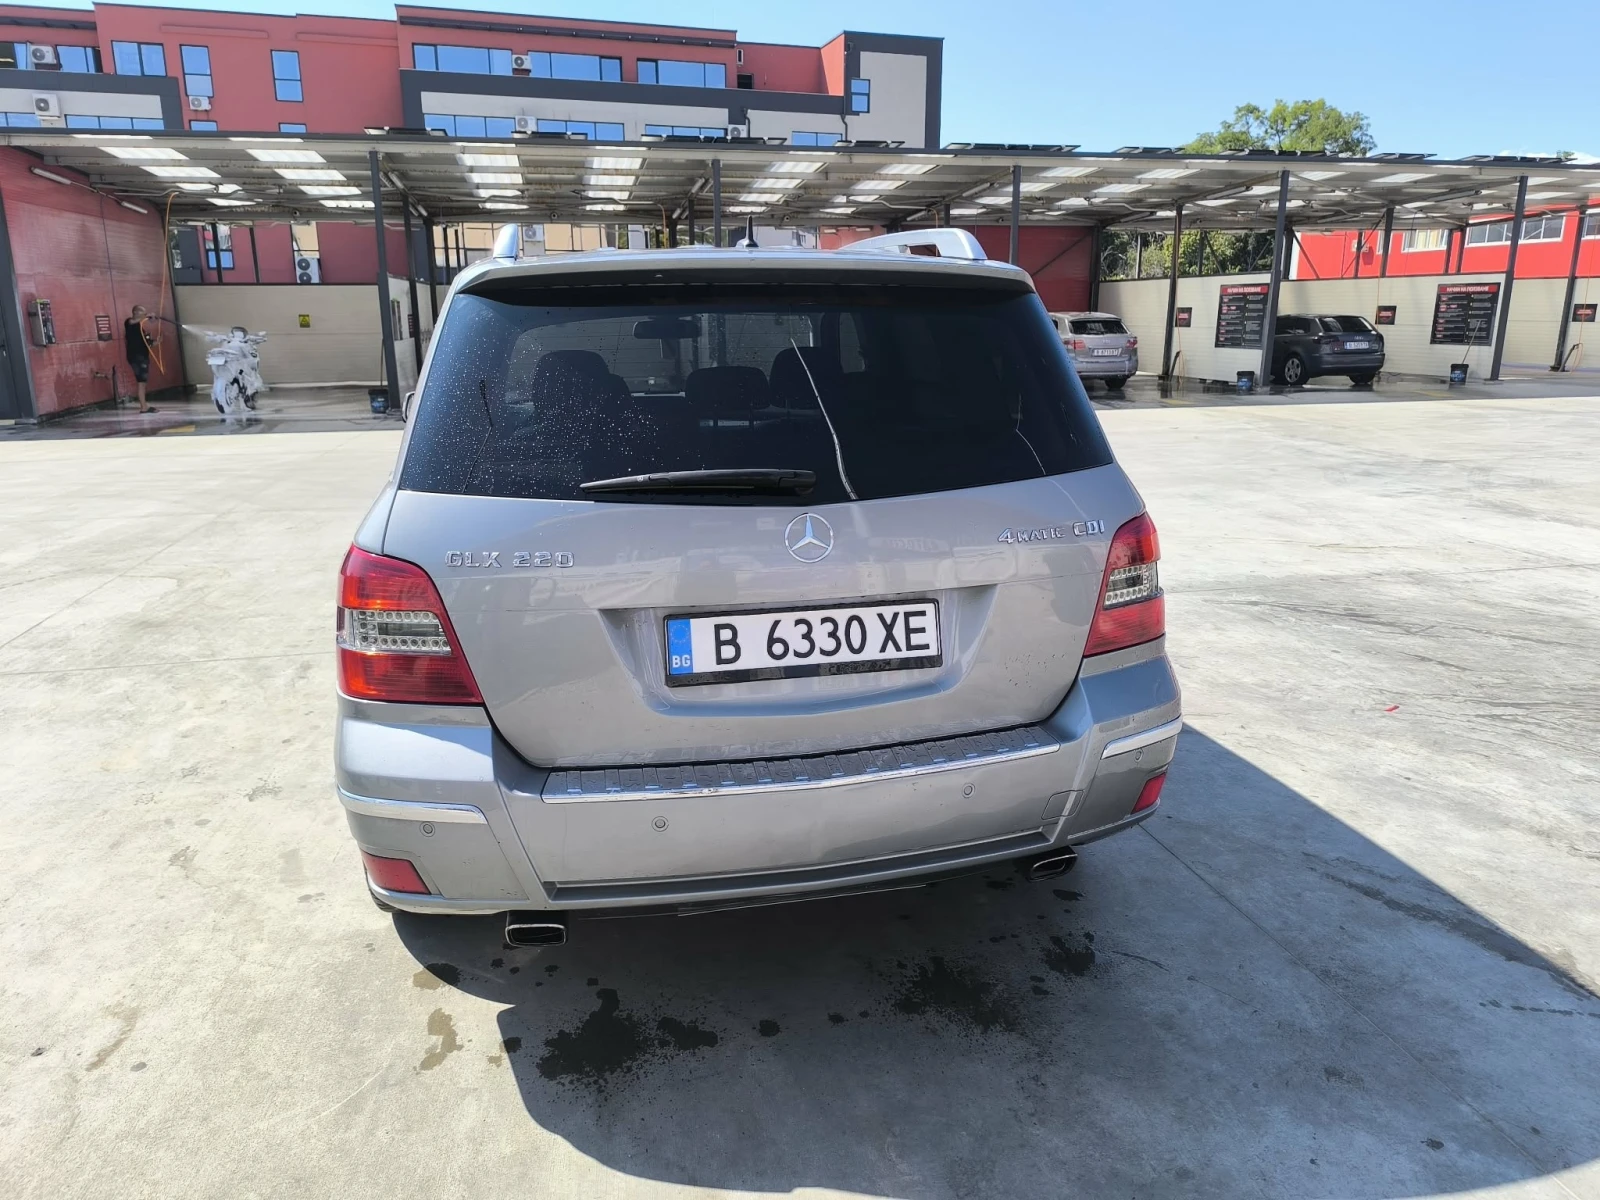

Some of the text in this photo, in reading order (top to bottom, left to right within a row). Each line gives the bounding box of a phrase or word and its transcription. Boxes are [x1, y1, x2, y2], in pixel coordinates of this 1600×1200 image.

[998, 519, 1105, 544] 4MATIC CDI
[445, 550, 575, 568] GLK 220
[713, 610, 930, 666] B 6330 XE
[672, 655, 691, 668] BG
